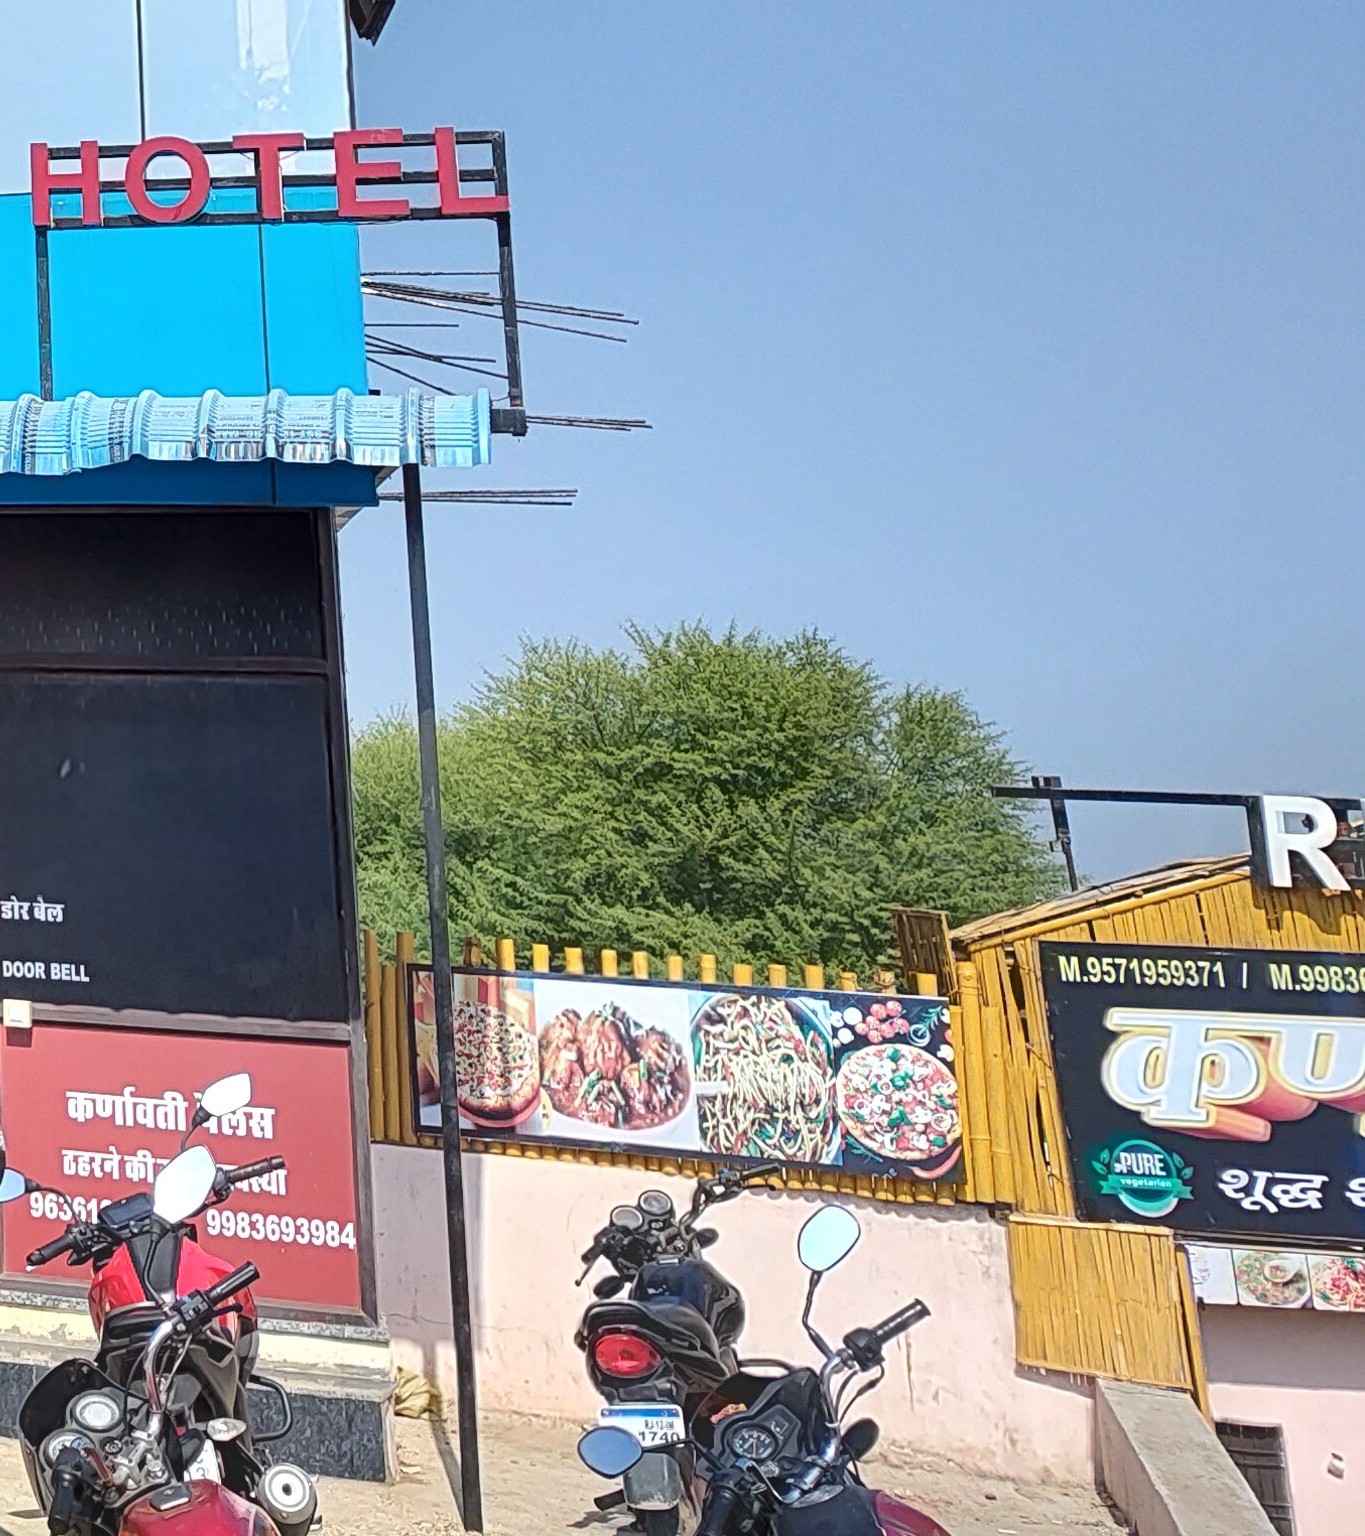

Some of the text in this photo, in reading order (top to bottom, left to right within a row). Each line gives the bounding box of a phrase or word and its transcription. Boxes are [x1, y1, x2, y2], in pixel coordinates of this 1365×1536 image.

[30, 127, 510, 226] HOTEL
[1260, 794, 1365, 892] R
[0, 893, 65, 922] डोर बेल
[1, 960, 90, 982] DOOR BELL
[1058, 955, 1226, 988] M.9571959371
[65, 1086, 189, 1131] कर्णावती
[61, 1145, 122, 1180] ठहरने
[123, 1149, 155, 1183] की
[1118, 1152, 1167, 1176] PURE
[1120, 1178, 1173, 1188] vegetarian
[206, 1209, 356, 1249] 9983693984
